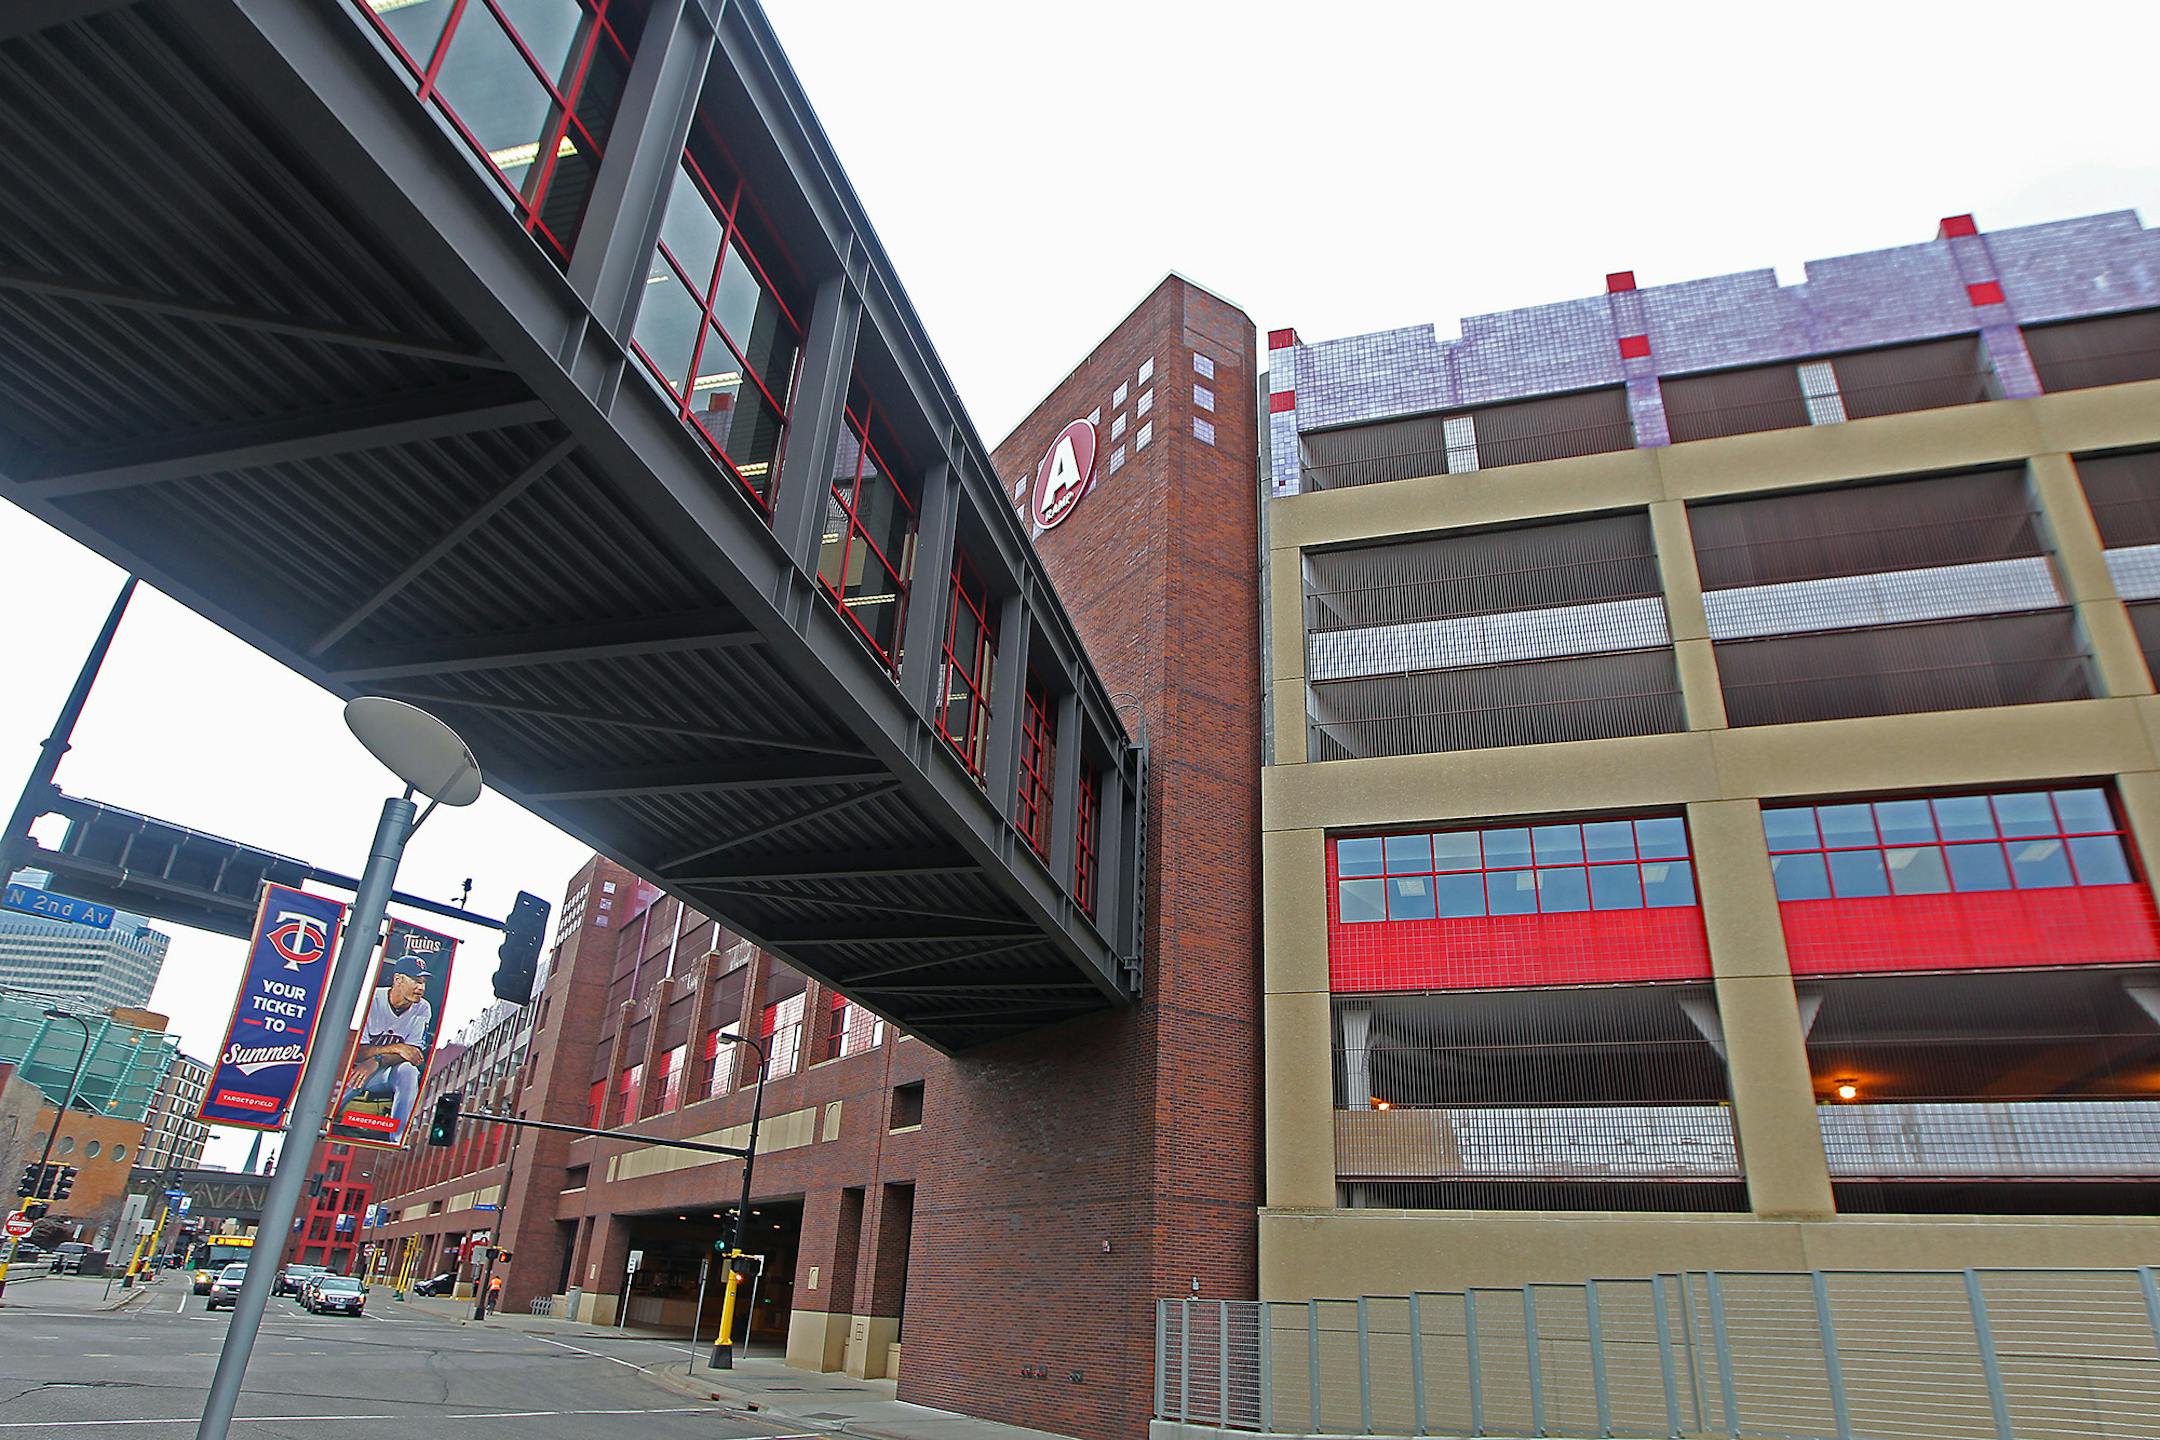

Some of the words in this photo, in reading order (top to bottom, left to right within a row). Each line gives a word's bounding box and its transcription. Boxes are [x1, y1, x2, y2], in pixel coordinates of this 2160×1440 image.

[1040, 435, 1081, 513] A
[1045, 491, 1075, 522] RAMP
[9, 889, 25, 905] N
[33, 895, 74, 916] 2nd
[81, 907, 108, 924] Av
[403, 933, 441, 953] Twins
[262, 979, 306, 1001] YOUR
[253, 996, 307, 1019] TICKET
[264, 1017, 286, 1033] TO
[222, 1043, 305, 1066] Summer
[223, 1094, 250, 1105] TARGET
[254, 1100, 274, 1108] FIELD
[347, 1115, 372, 1125] TARGET
[376, 1120, 395, 1128] FIELD
